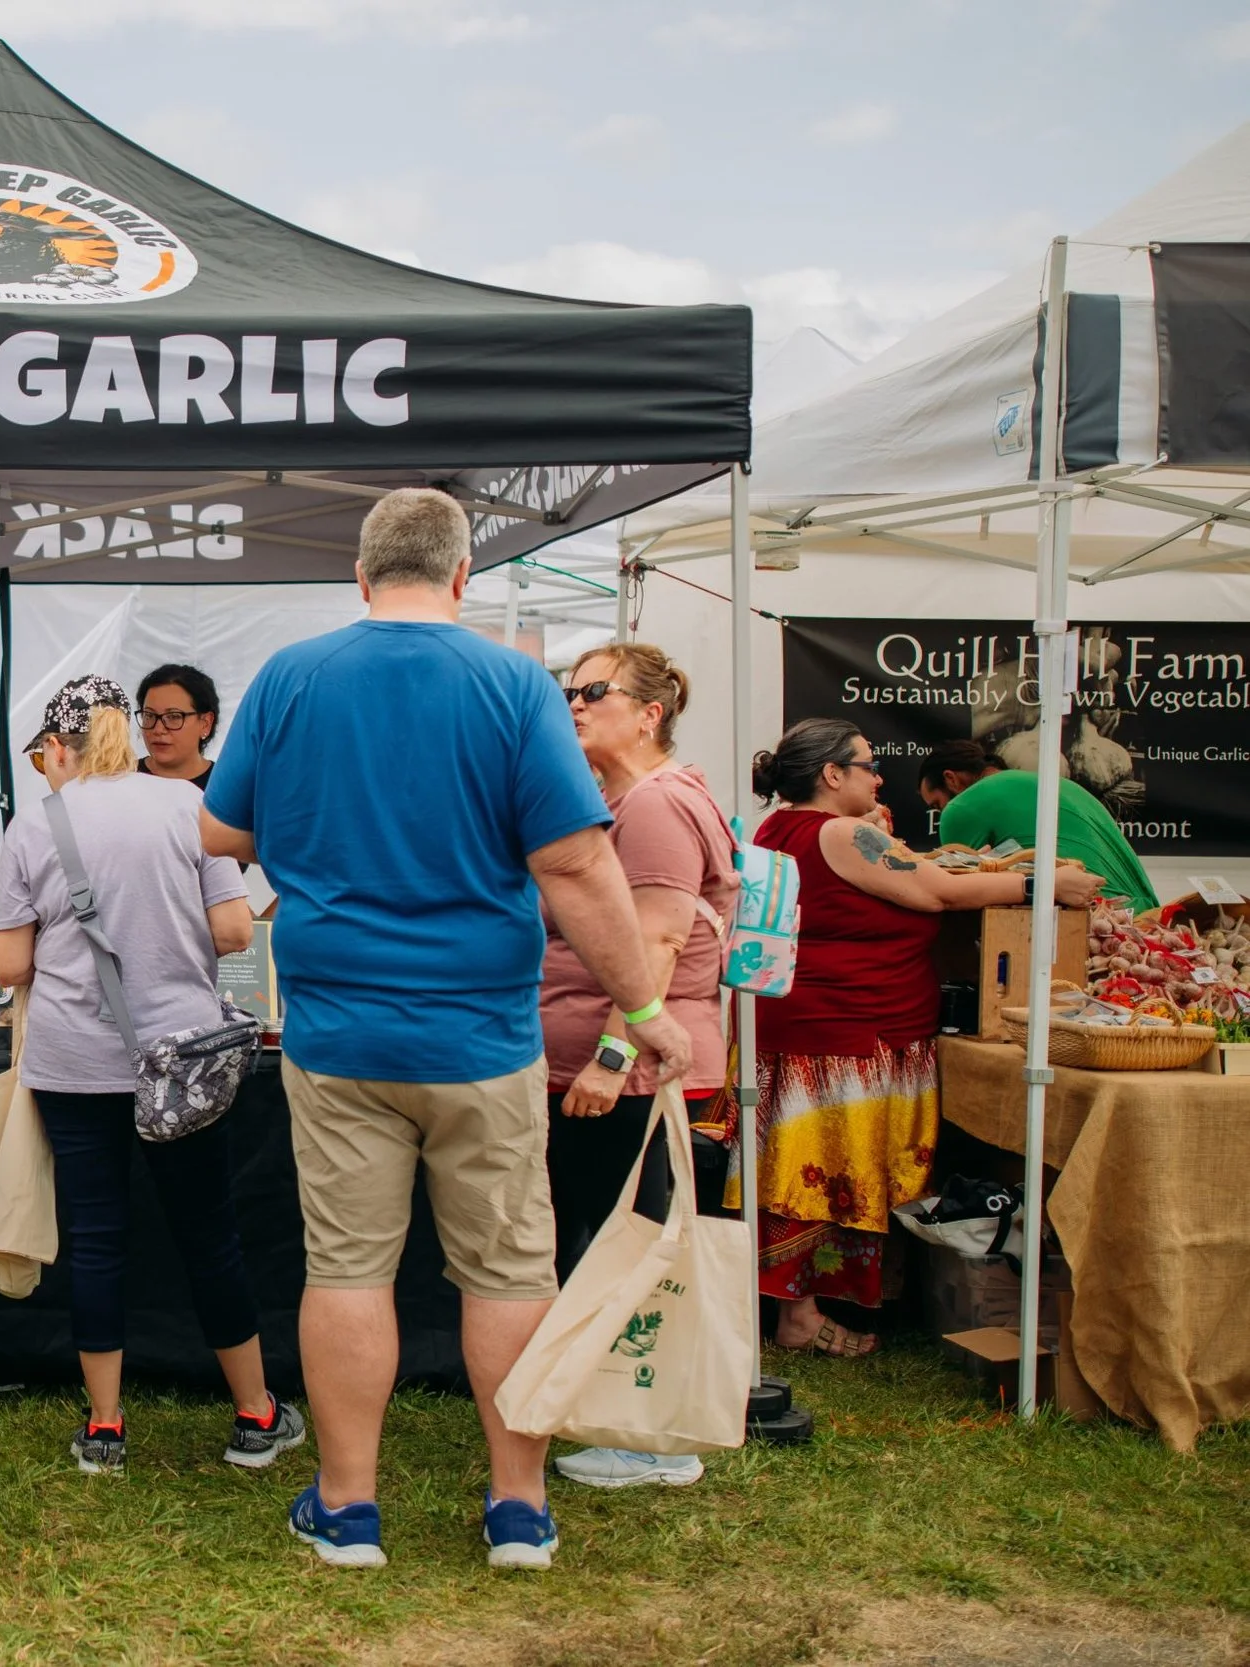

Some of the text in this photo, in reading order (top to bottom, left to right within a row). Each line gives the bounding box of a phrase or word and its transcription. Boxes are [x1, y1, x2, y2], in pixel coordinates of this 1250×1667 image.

[56, 186, 179, 251] GARLIC
[876, 633, 1247, 682] Quill Hll Farm
[841, 676, 1008, 712] Sustainably
[1015, 679, 1115, 707] Gwn
[1147, 746, 1250, 764] Unique Garlic
[1118, 817, 1192, 839] mont
